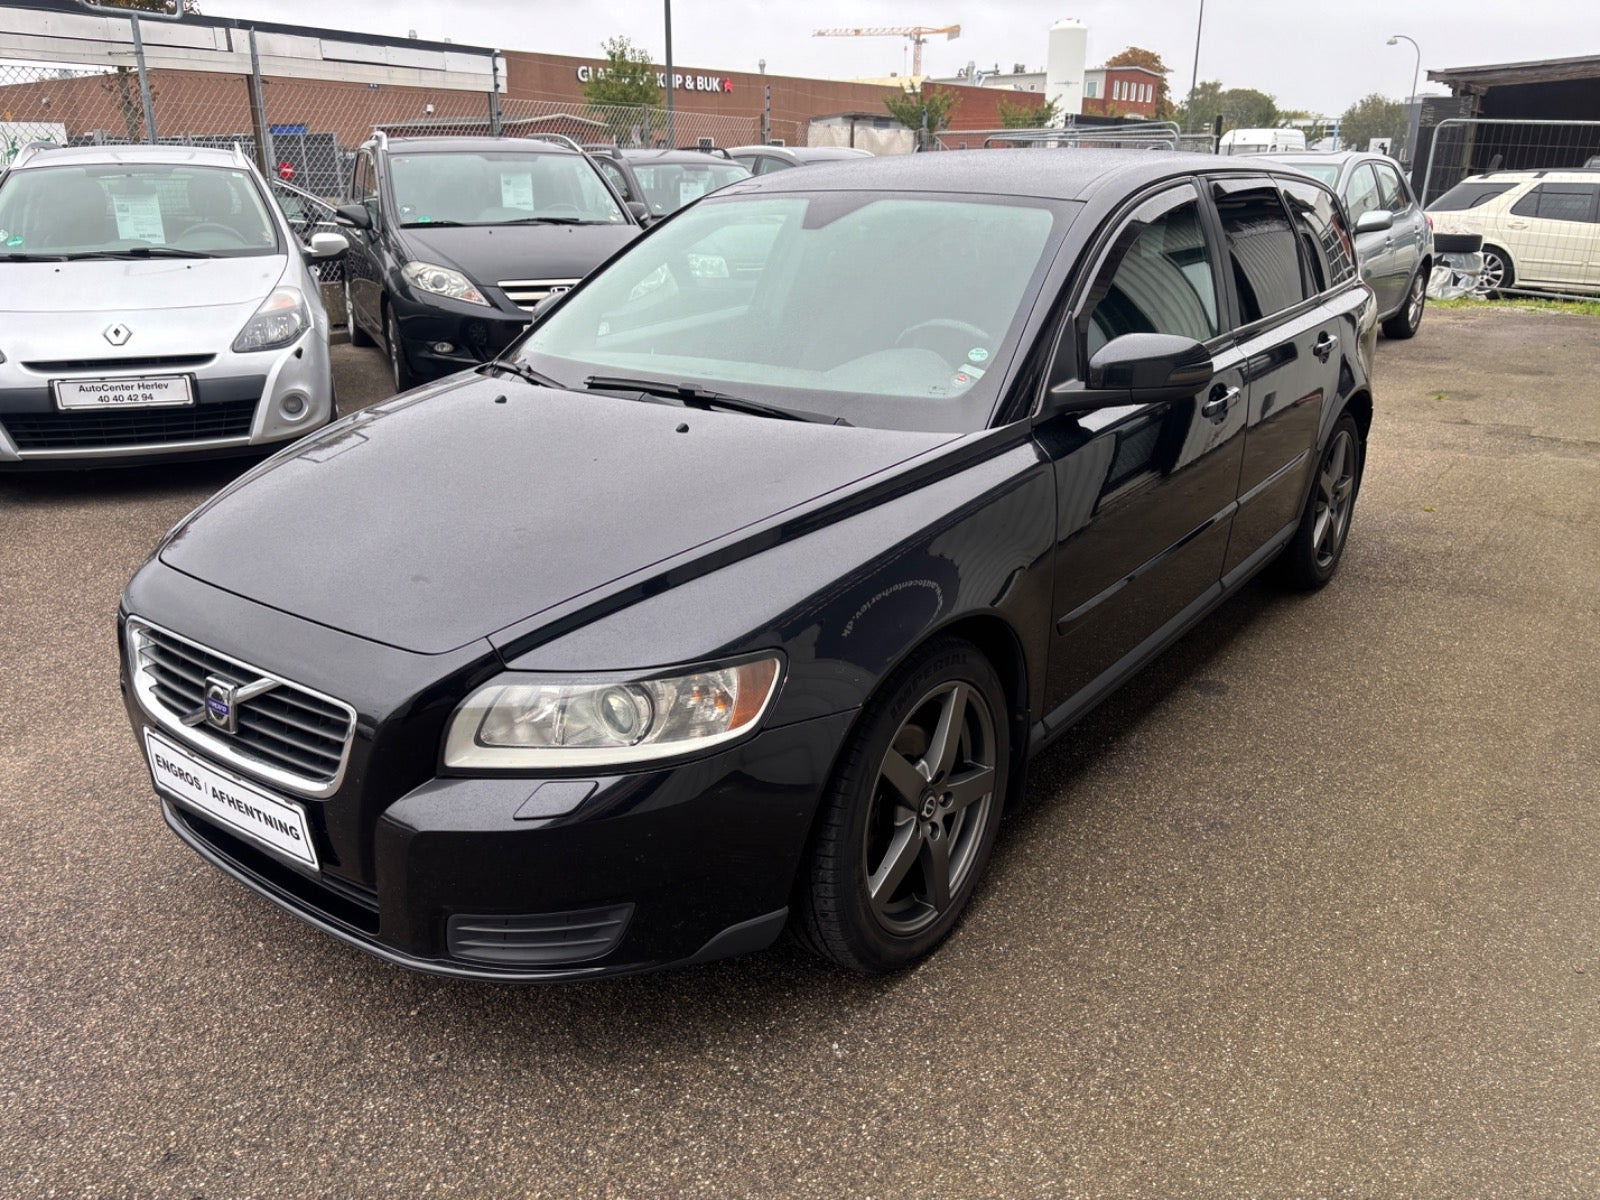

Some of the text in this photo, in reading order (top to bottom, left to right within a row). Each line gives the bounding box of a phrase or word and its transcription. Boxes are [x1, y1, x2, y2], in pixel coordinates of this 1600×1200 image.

[656, 72, 683, 89] KIP
[685, 75, 695, 90] &
[696, 75, 721, 92] BUK
[78, 382, 169, 393] AutoCenter Herlev
[97, 393, 153, 403] 40 40 42 94
[155, 753, 202, 791] ENGROS
[211, 786, 301, 841] AFHENTNING
